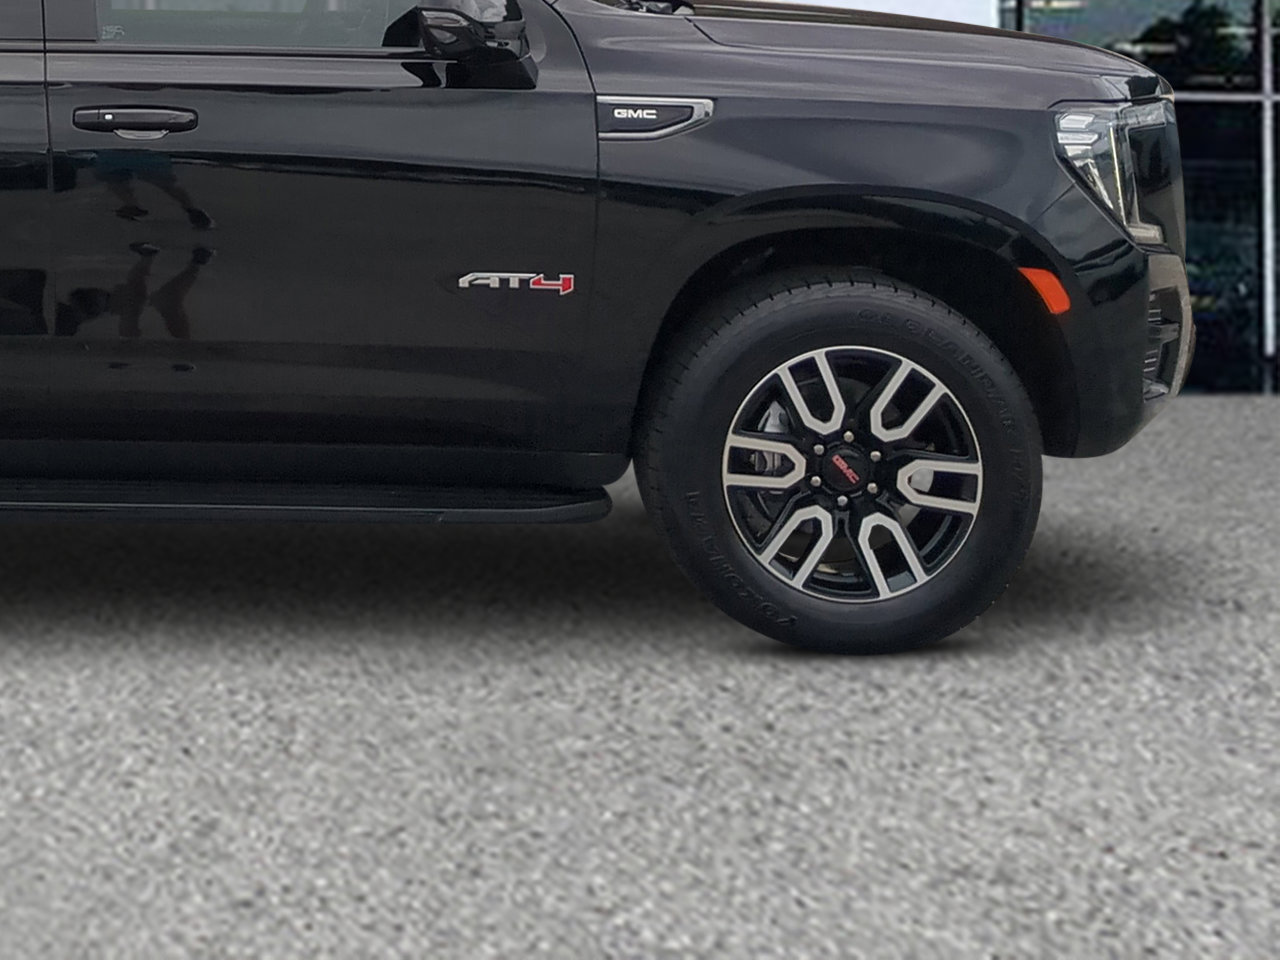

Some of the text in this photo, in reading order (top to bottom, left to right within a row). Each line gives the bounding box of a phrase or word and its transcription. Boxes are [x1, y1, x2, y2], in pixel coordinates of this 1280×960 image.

[613, 108, 658, 119] GMC
[458, 272, 574, 295] AT4
[831, 454, 860, 484] GMC
